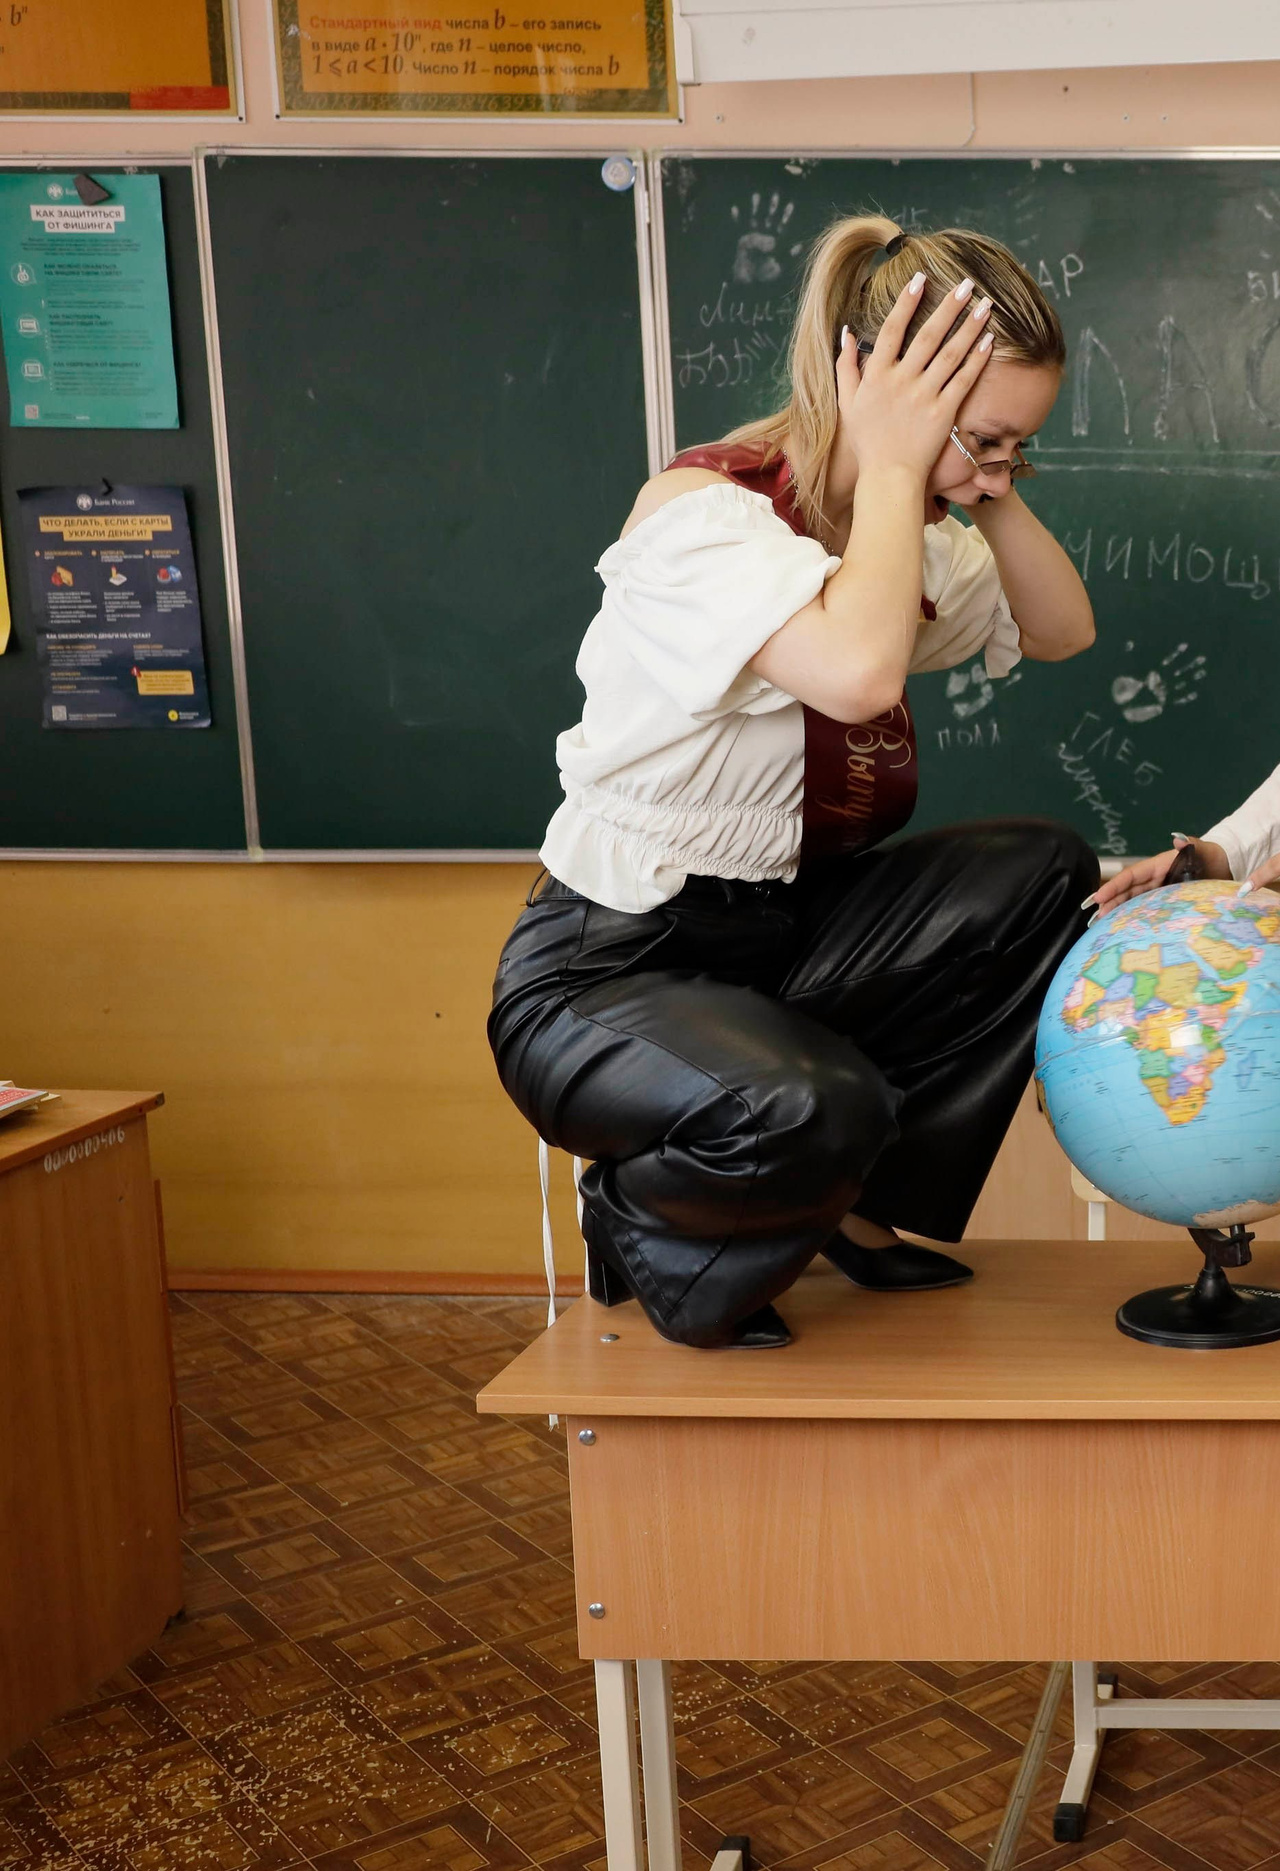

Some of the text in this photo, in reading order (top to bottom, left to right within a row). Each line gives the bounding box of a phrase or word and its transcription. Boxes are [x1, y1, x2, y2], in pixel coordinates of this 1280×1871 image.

[309, 15, 409, 31] Стандартный
[413, 18, 441, 31] вид
[446, 18, 489, 31] числа
[494, 8, 506, 30] b
[522, 20, 546, 31] его
[550, 19, 602, 31] запись
[312, 42, 321, 53] в
[325, 41, 360, 54] виде
[430, 42, 454, 55] где
[458, 36, 472, 53] n
[489, 42, 533, 55] целое
[537, 42, 586, 55] число,
[413, 59, 459, 76] Число
[463, 59, 477, 76] n
[494, 63, 557, 78] порядок
[560, 63, 604, 77] числа
[608, 55, 620, 76] b
[35, 209, 121, 220] КАК ЗАЩИТИТЬСЯ
[47, 221, 113, 231] ОТ ФИШИНГА
[94, 498, 110, 506] Банк
[42, 518, 168, 528] ЧТО ДЕЛАТЬ, ЕСЛИ С КАРТЫ
[68, 529, 147, 539] УКРАЛИ ДЕНЬГИ?
[1070, 711, 1164, 787] ГЛЕБ
